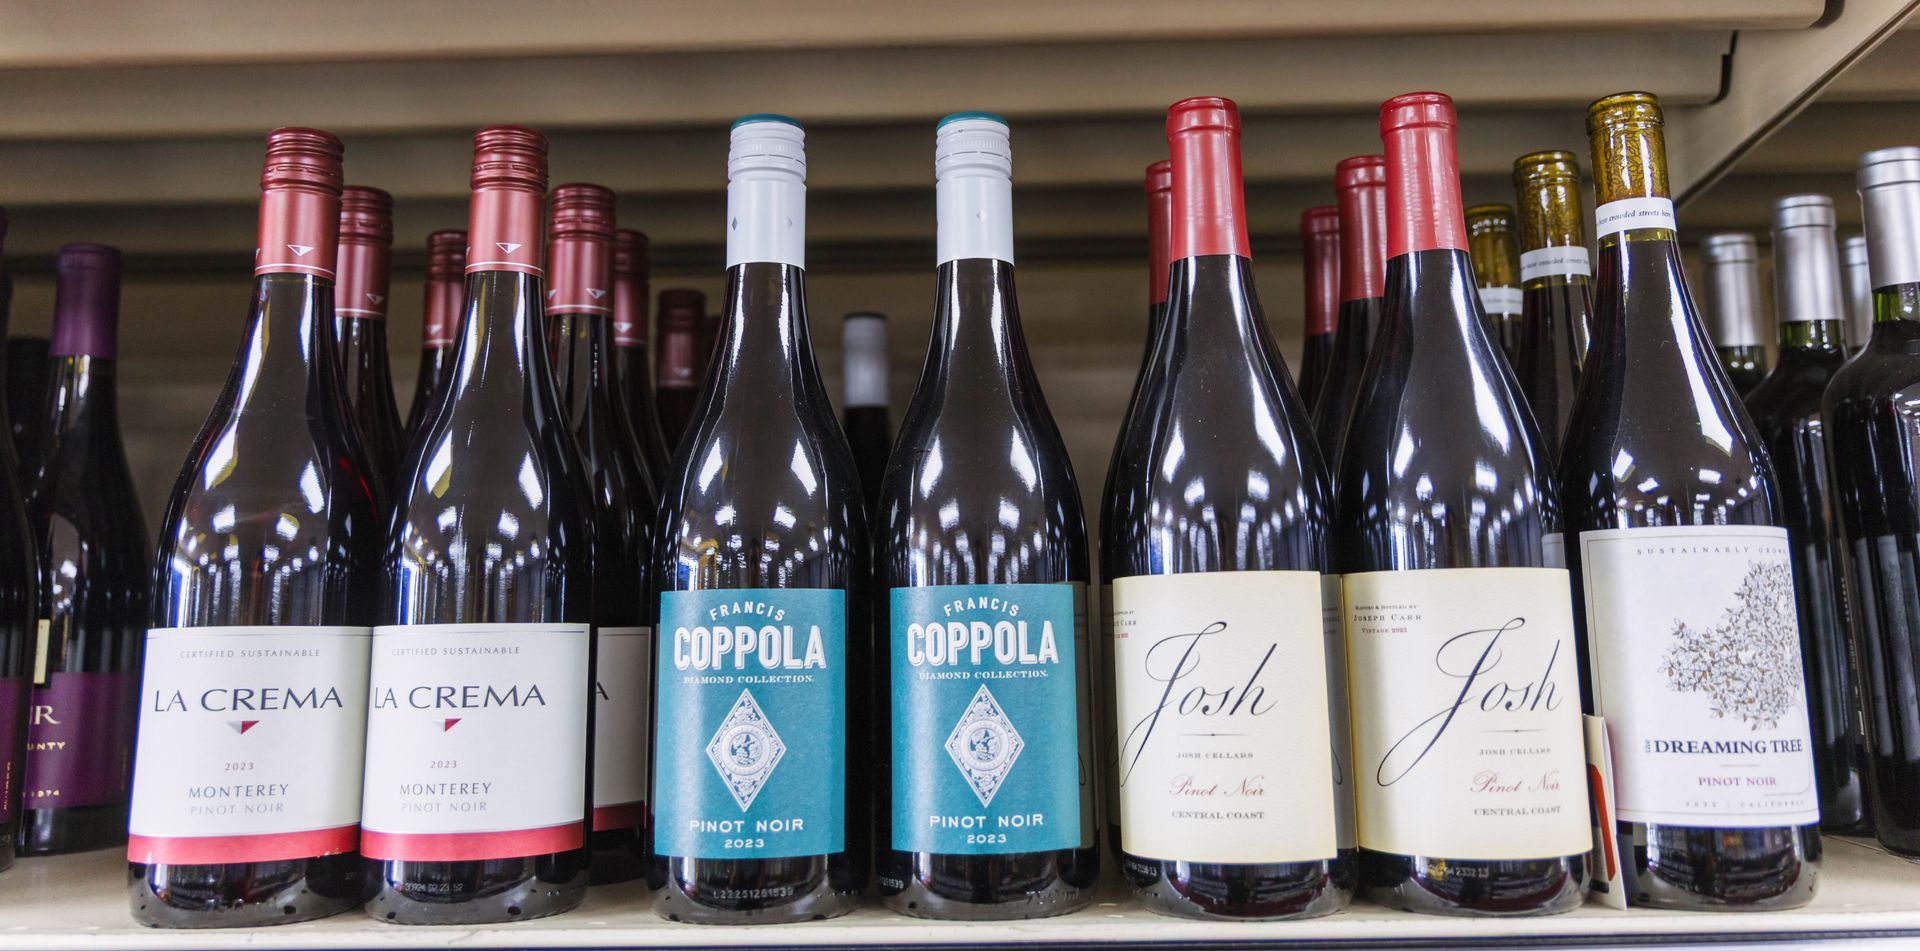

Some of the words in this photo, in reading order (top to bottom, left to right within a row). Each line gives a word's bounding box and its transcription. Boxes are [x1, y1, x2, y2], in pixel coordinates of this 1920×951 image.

[1637, 547, 1749, 555] SUSTAINABLY
[710, 601, 786, 622] FRANCIS
[943, 596, 1019, 617] FRANCIS
[674, 624, 827, 670] COPPOLA
[907, 620, 1059, 666] COPPOLA
[180, 649, 235, 659] CERTIFIED
[240, 648, 321, 658] SUSTAINABLE
[391, 647, 438, 657] CERTIFIED
[442, 646, 520, 656] SUSTAINABLE
[683, 675, 734, 684] DIAMOND
[919, 671, 971, 680] DIAMOND
[154, 689, 188, 713] LA
[200, 686, 344, 713] CREMA
[374, 687, 398, 709] LA
[408, 683, 546, 709] CREMA
[1377, 616, 1564, 787] Josh
[1120, 621, 1279, 788] Josh
[1479, 748, 1507, 756] JOSH
[1509, 747, 1552, 755] CELLARS
[1654, 739, 1767, 754] DREAMING
[1769, 739, 1803, 753] TREE
[1176, 752, 1202, 760] JOSH
[1205, 751, 1254, 759] CELLARS
[224, 762, 255, 772] 2023
[429, 760, 457, 769] 2023
[1168, 775, 1215, 797] Pinot
[1223, 775, 1265, 797] Noir
[1470, 769, 1522, 794] Pinot
[1528, 768, 1561, 792] Noir
[1698, 777, 1741, 787] PINOT
[1746, 776, 1777, 786] NOIR
[188, 783, 289, 800] MONTEREY
[399, 782, 492, 796] MONTEREY
[190, 804, 235, 816] PINOT
[244, 803, 285, 814] NOIR
[402, 802, 442, 814] PINOT
[449, 801, 487, 812] NOIR
[1474, 807, 1529, 817] CENTRAL
[1531, 806, 1561, 815] COAST
[929, 815, 987, 829] PINOT
[998, 814, 1044, 827] NOIR
[1171, 810, 1224, 820] CENTRAL
[1226, 811, 1265, 820] COAST
[689, 820, 745, 833] PINOT
[756, 819, 804, 832] NOIR
[724, 838, 765, 849] 2023
[967, 834, 1007, 845] 2023
